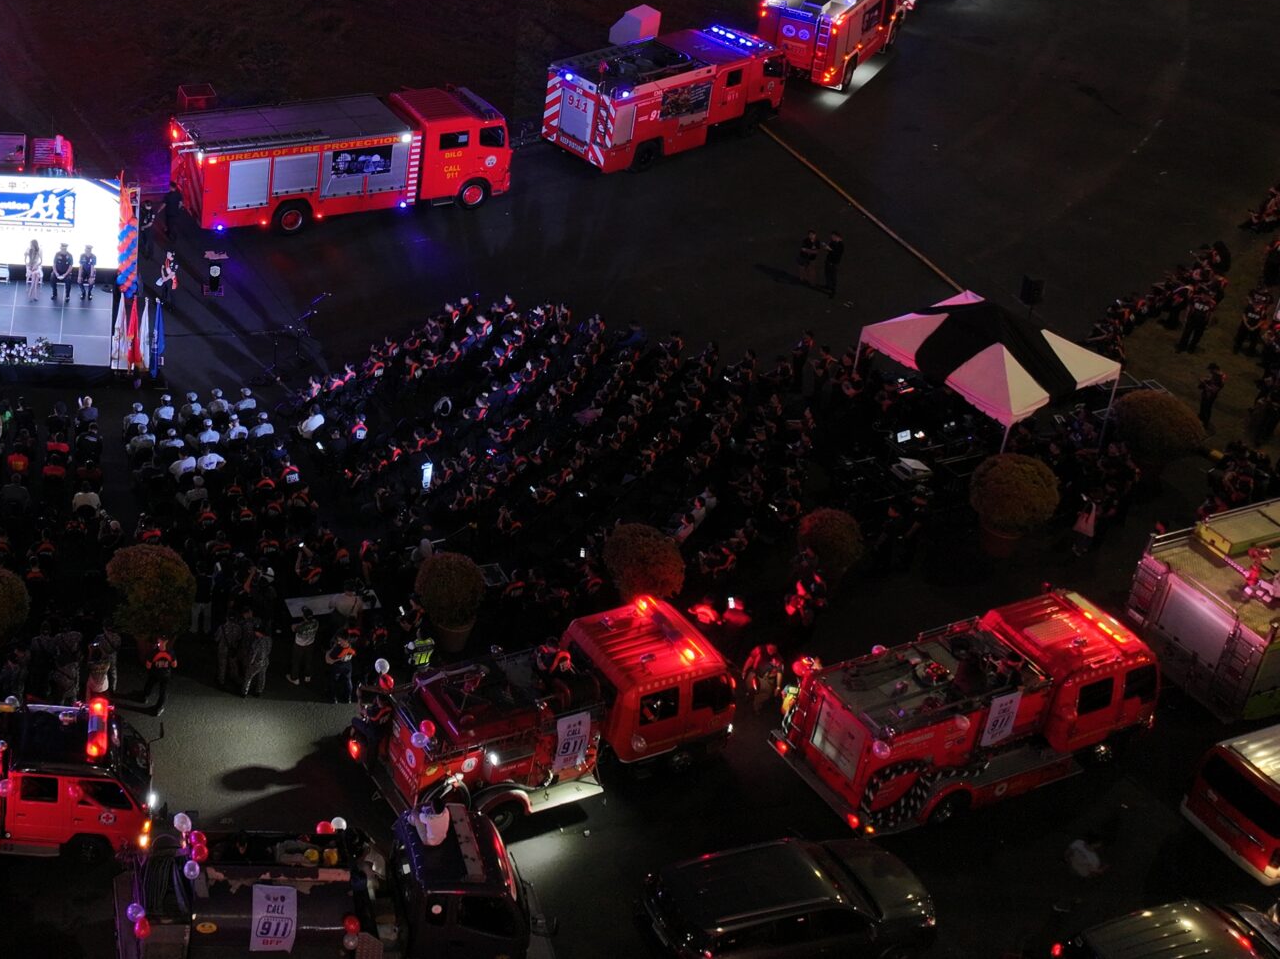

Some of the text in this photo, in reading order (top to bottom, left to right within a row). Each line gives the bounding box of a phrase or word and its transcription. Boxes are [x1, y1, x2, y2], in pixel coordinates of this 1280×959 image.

[567, 95, 588, 114] 911
[220, 136, 402, 162] BUREAU OF FIRE PROTECTION
[443, 164, 461, 173] CALL
[561, 739, 584, 754] 911
[266, 904, 285, 914] CALL
[260, 921, 289, 937] 911
